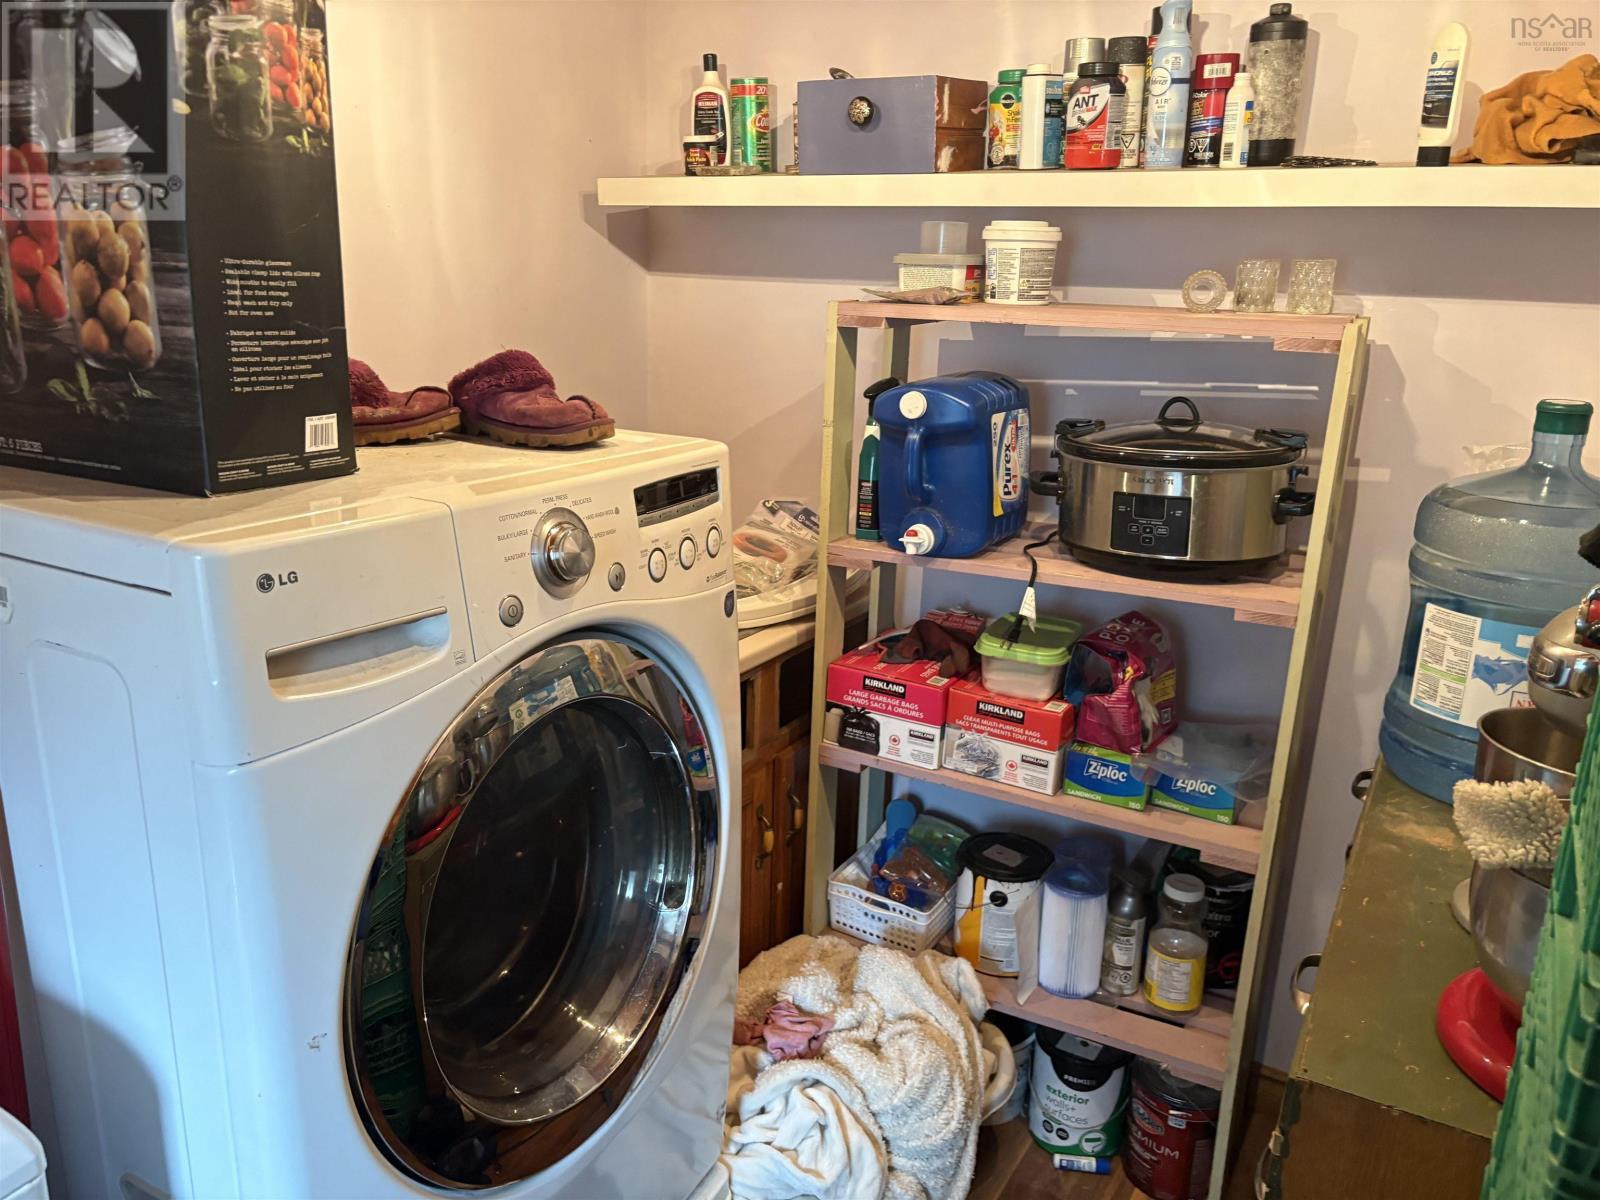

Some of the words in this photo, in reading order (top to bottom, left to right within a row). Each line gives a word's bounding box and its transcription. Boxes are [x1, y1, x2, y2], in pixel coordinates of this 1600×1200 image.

[756, 86, 768, 95] 20
[1072, 93, 1100, 110] ANT
[1003, 443, 1012, 496] Purex
[504, 552, 528, 563] SANITARY
[278, 571, 299, 586] LG
[864, 678, 905, 693] KIRKLAND
[843, 694, 869, 706] GRANDS
[870, 700, 886, 710] SACS
[887, 702, 893, 711] À
[893, 706, 924, 719] ORDURES
[849, 689, 869, 699] LARGE
[869, 693, 901, 706] GARBAGE
[901, 700, 919, 711] BAGS
[978, 702, 1024, 718] KIRKLAND
[955, 719, 970, 728] SACS
[970, 722, 1012, 737] TRANSPARENTS
[1012, 732, 1028, 741] TOUT
[1028, 736, 1048, 746] USAGE
[963, 714, 981, 724] CLEAR
[981, 718, 1024, 733] MULTI-PURPOSE
[1025, 729, 1041, 738] BAGS
[910, 730, 935, 739] KIRKLAND
[1022, 755, 1048, 766] KIRKLAND
[1088, 761, 1128, 782] Ziploc
[1067, 788, 1102, 801] SANDWICH
[1128, 801, 1141, 810] 150
[1154, 798, 1190, 811] SANDWICH
[1216, 815, 1229, 823] 150
[1046, 1084, 1090, 1105] exterior
[1131, 1125, 1180, 1160] EMIUM
